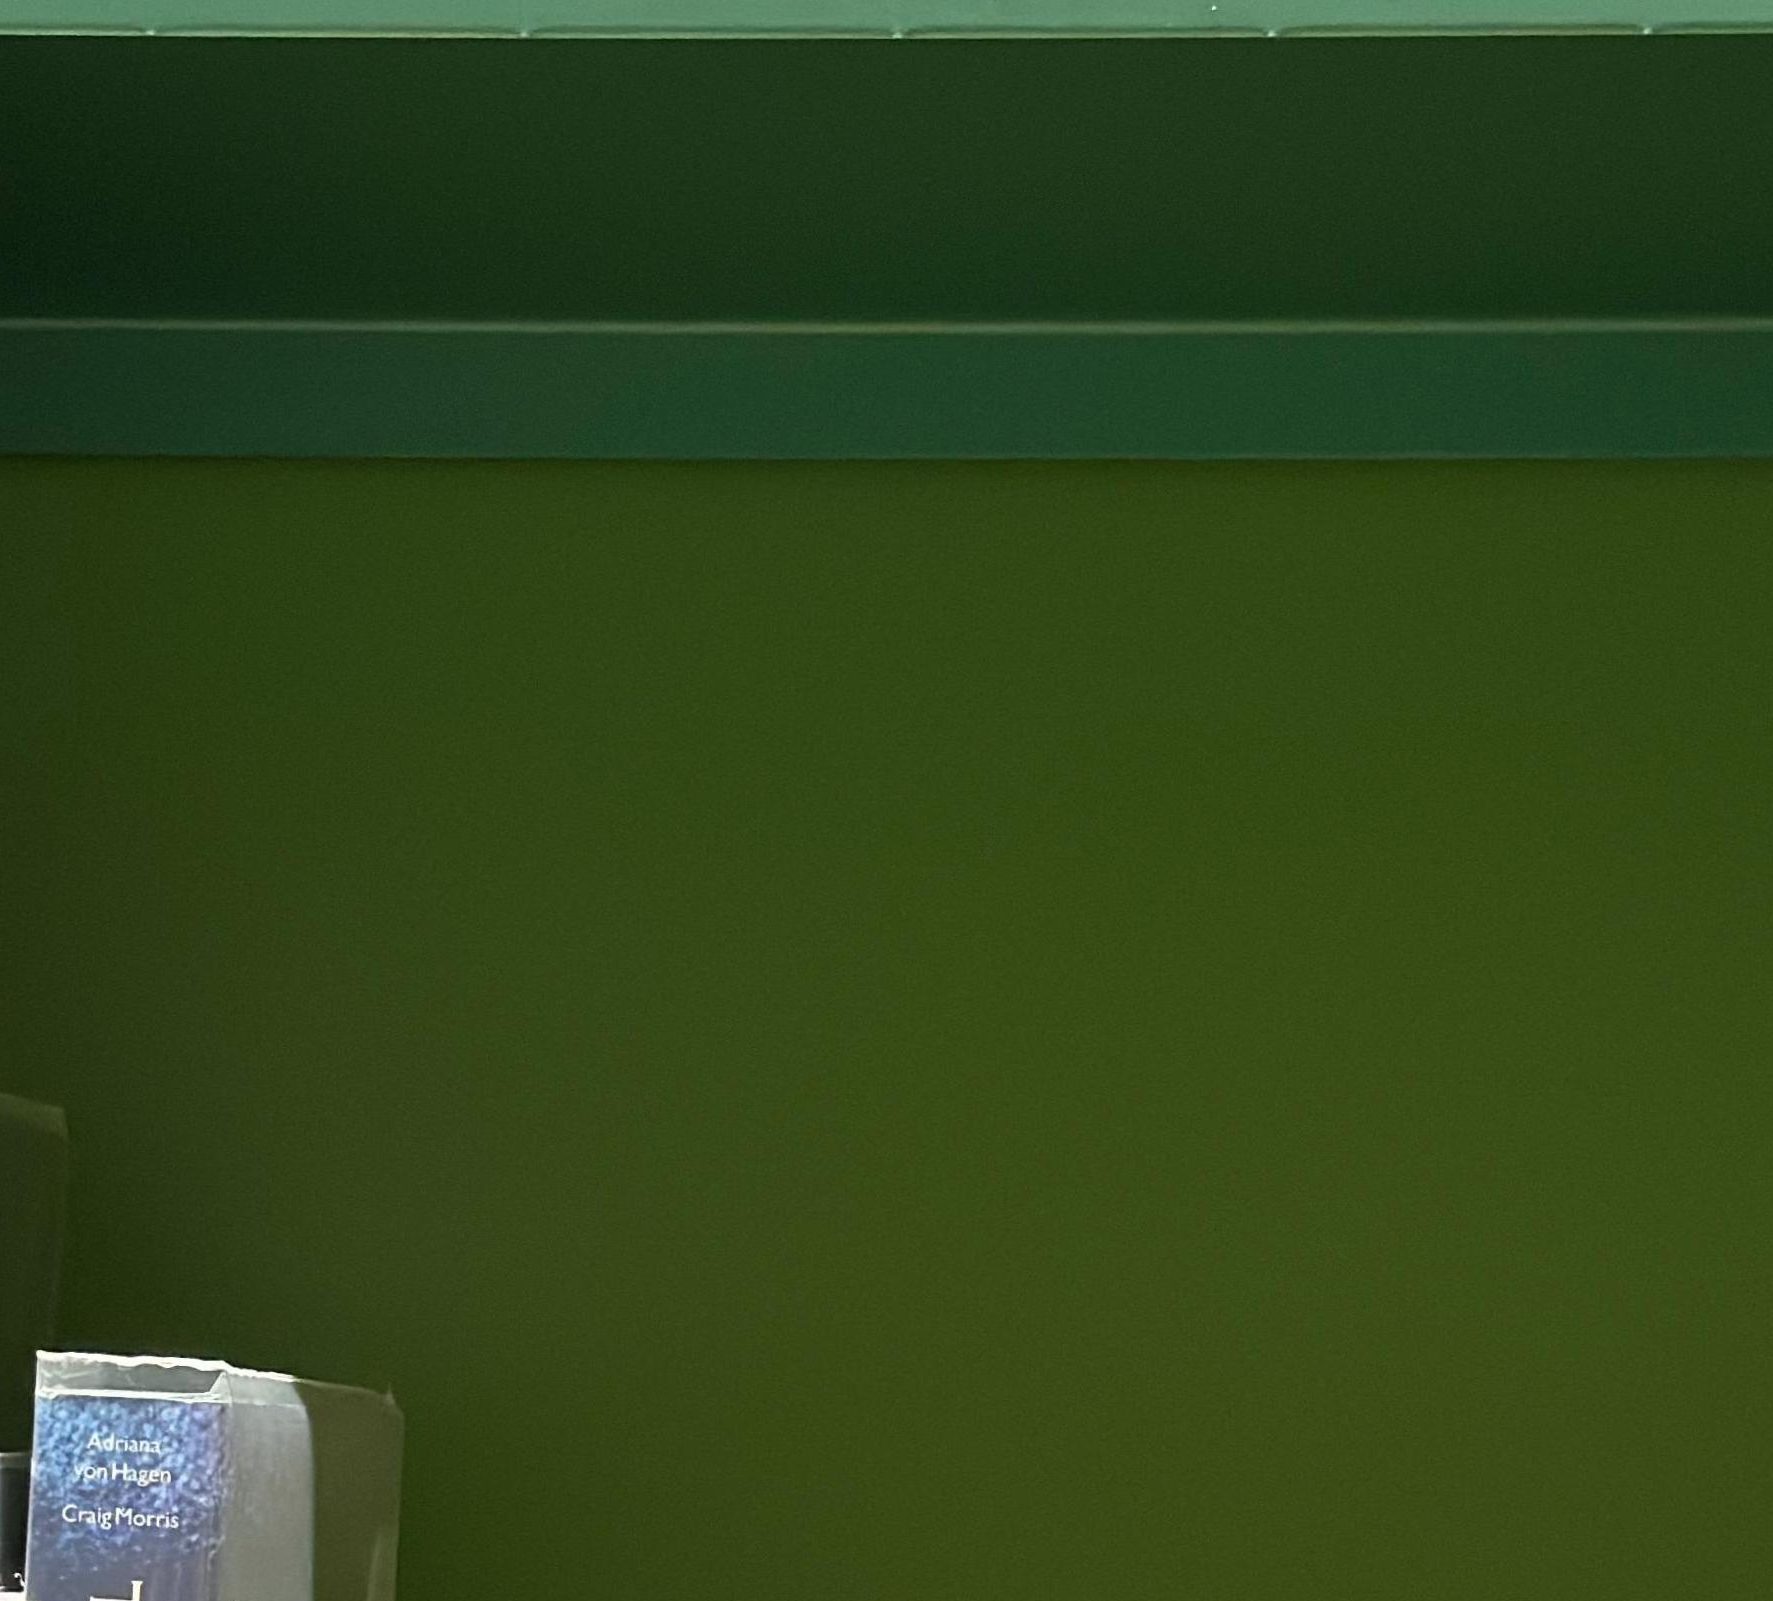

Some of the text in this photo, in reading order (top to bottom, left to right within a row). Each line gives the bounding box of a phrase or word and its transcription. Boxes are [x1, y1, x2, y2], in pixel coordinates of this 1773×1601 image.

[86, 1431, 163, 1455] Adriana
[74, 1461, 172, 1487] von Hagen
[61, 1503, 179, 1531] Craig Morris
